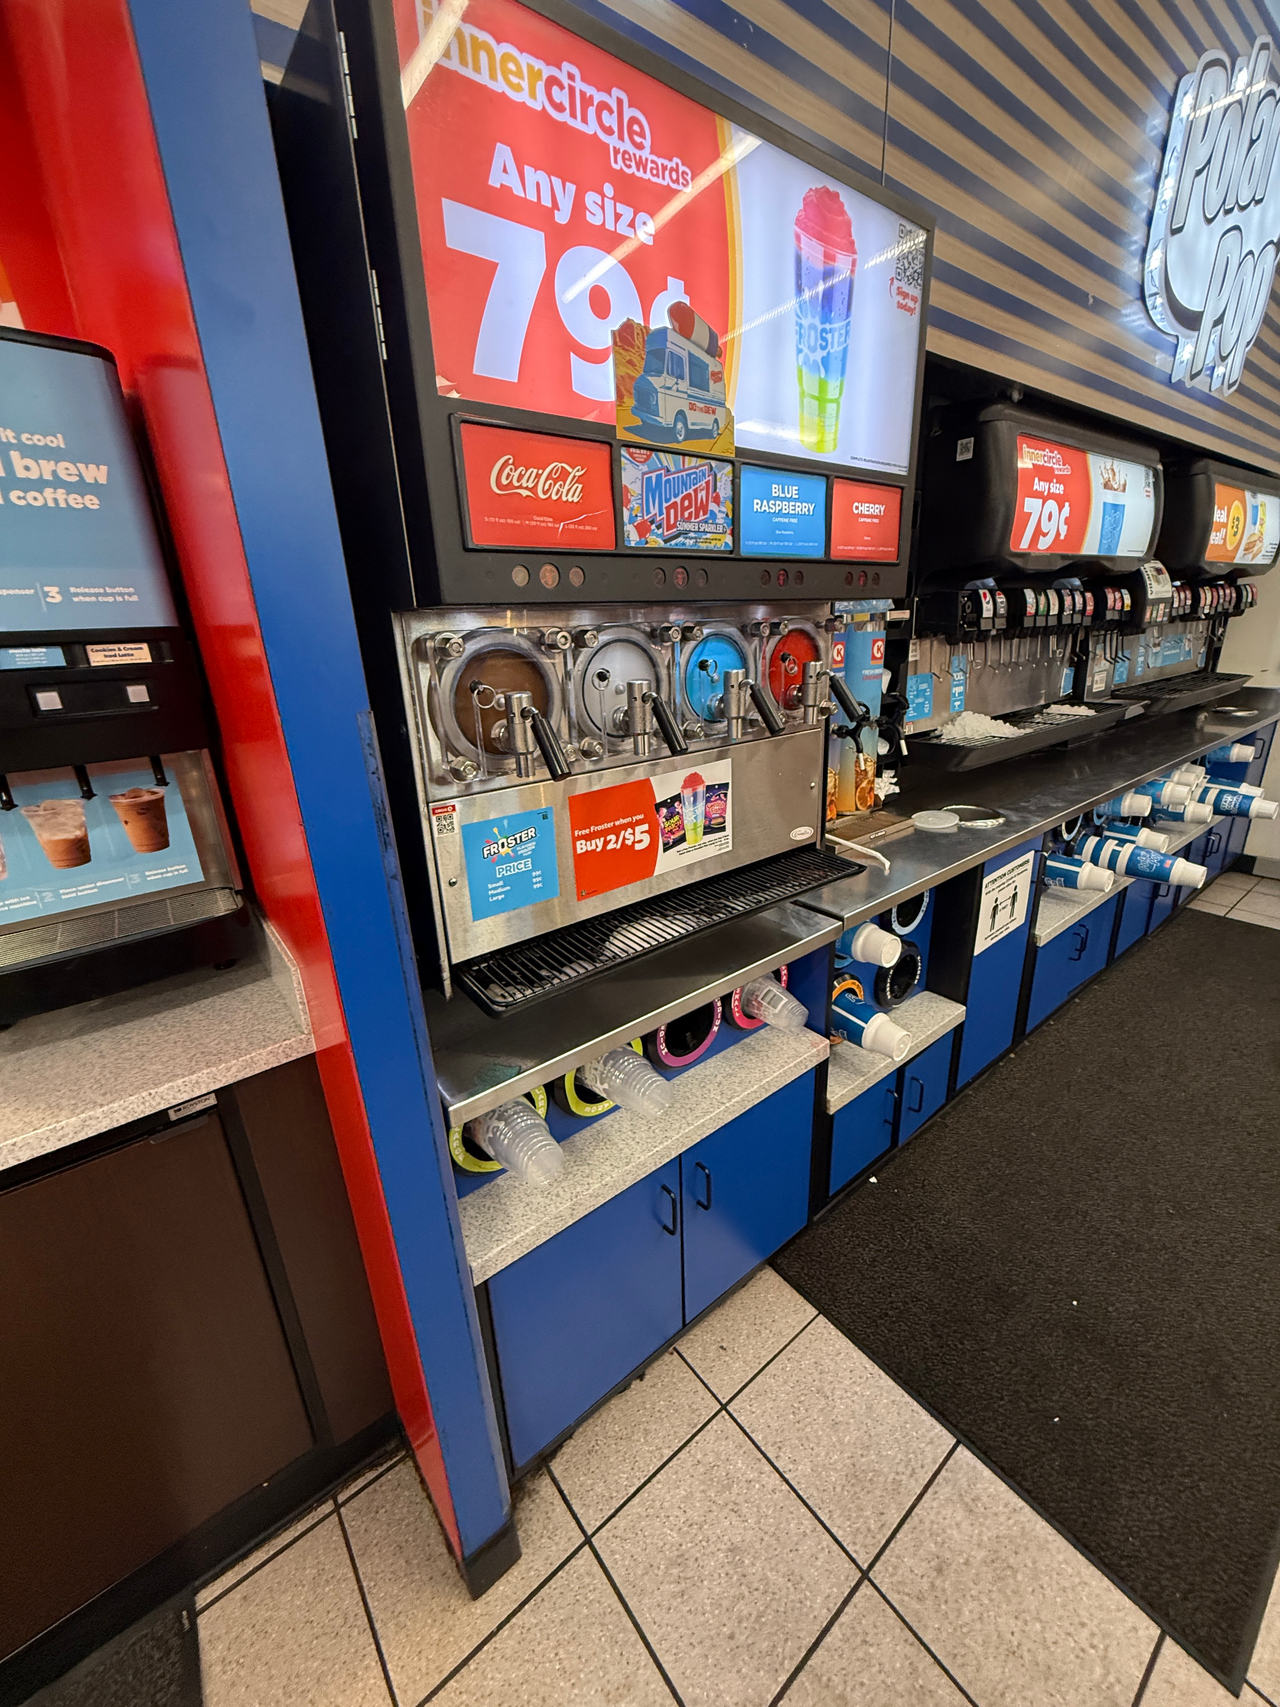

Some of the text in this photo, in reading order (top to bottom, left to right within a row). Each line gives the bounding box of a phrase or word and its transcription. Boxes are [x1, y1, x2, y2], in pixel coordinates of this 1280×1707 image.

[611, 144, 692, 188] rewards
[488, 142, 656, 245] Any size
[1190, 229, 1277, 392] Pop
[21, 432, 66, 449] cool
[1023, 444, 1062, 467] innercircle
[10, 450, 109, 485] brew
[489, 454, 588, 504] Coca-Cola
[771, 484, 799, 499] BLUE
[1033, 477, 1065, 496] Any size
[9, 488, 101, 510] coffee
[753, 499, 816, 515] RASPBERRY
[852, 502, 886, 515] CHERRY
[676, 521, 699, 532] SUMMER
[1019, 497, 1071, 550] 79¢
[43, 586, 62, 603] 3
[575, 813, 645, 838] Free Froster when you
[483, 826, 536, 859] FROSTER
[576, 835, 604, 854] Buy
[606, 823, 650, 851] 2/$5
[497, 859, 532, 877] PRICE
